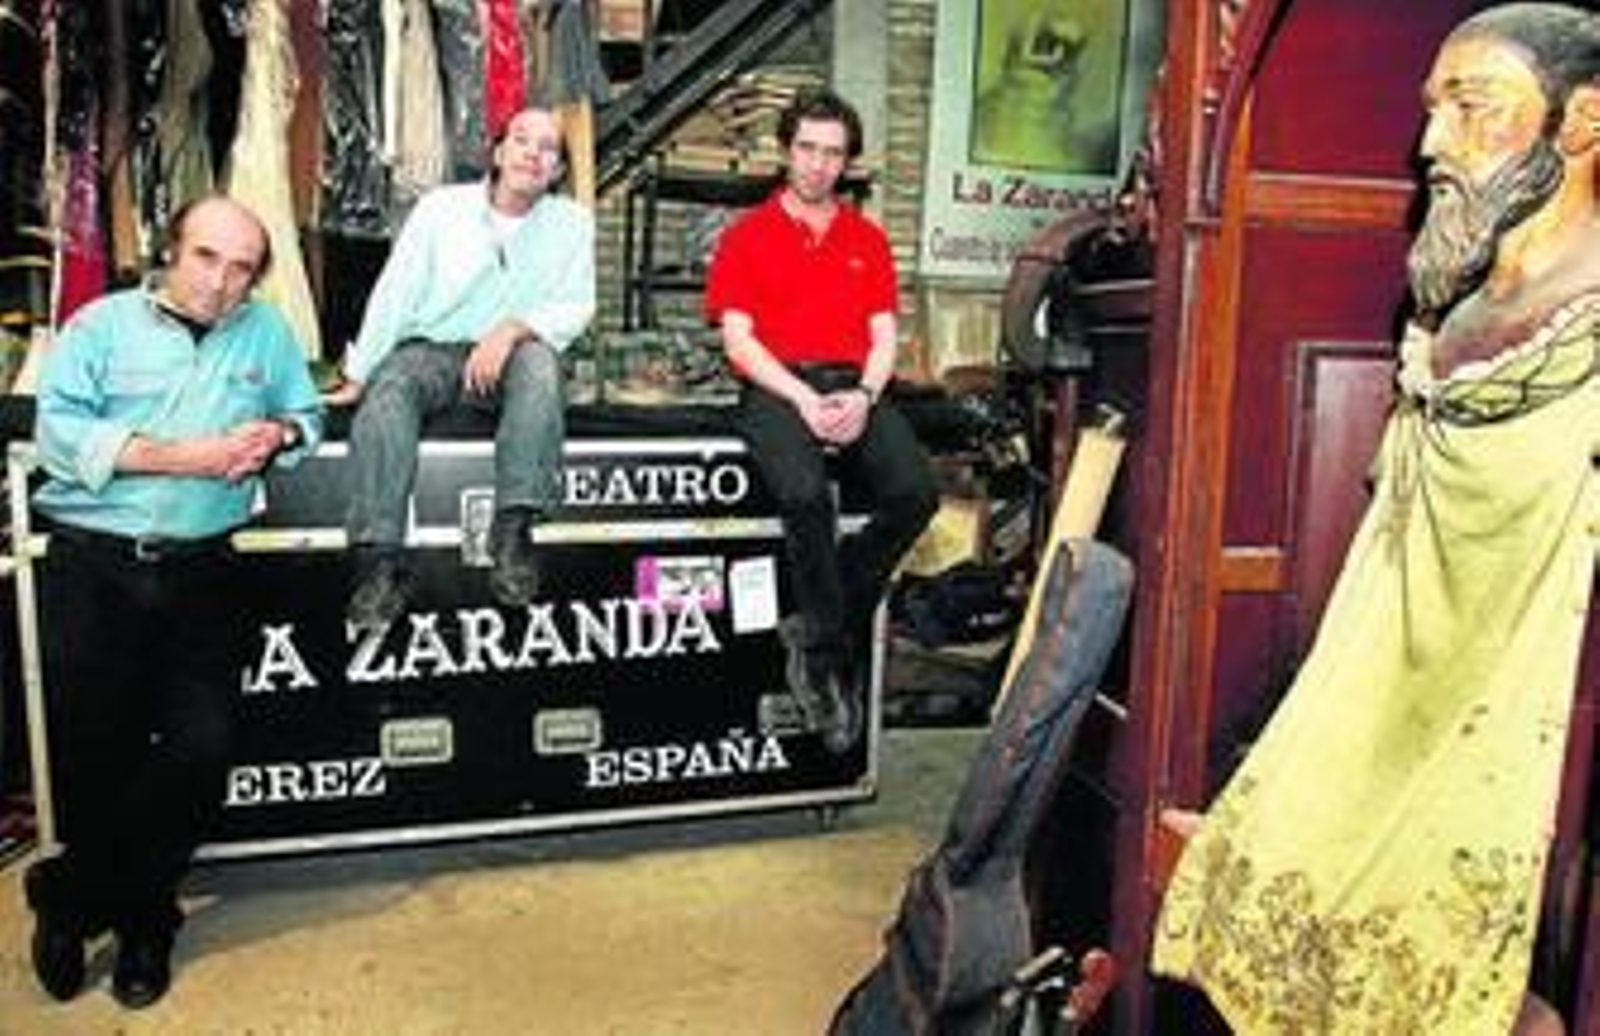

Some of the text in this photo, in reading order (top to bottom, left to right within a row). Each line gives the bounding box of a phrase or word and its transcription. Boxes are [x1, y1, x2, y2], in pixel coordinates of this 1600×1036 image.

[952, 174, 993, 205] La
[561, 463, 750, 506] EATRO
[345, 592, 721, 683] ZARANDA
[223, 757, 387, 808] EREZ
[585, 727, 792, 788] ESPAÑA
